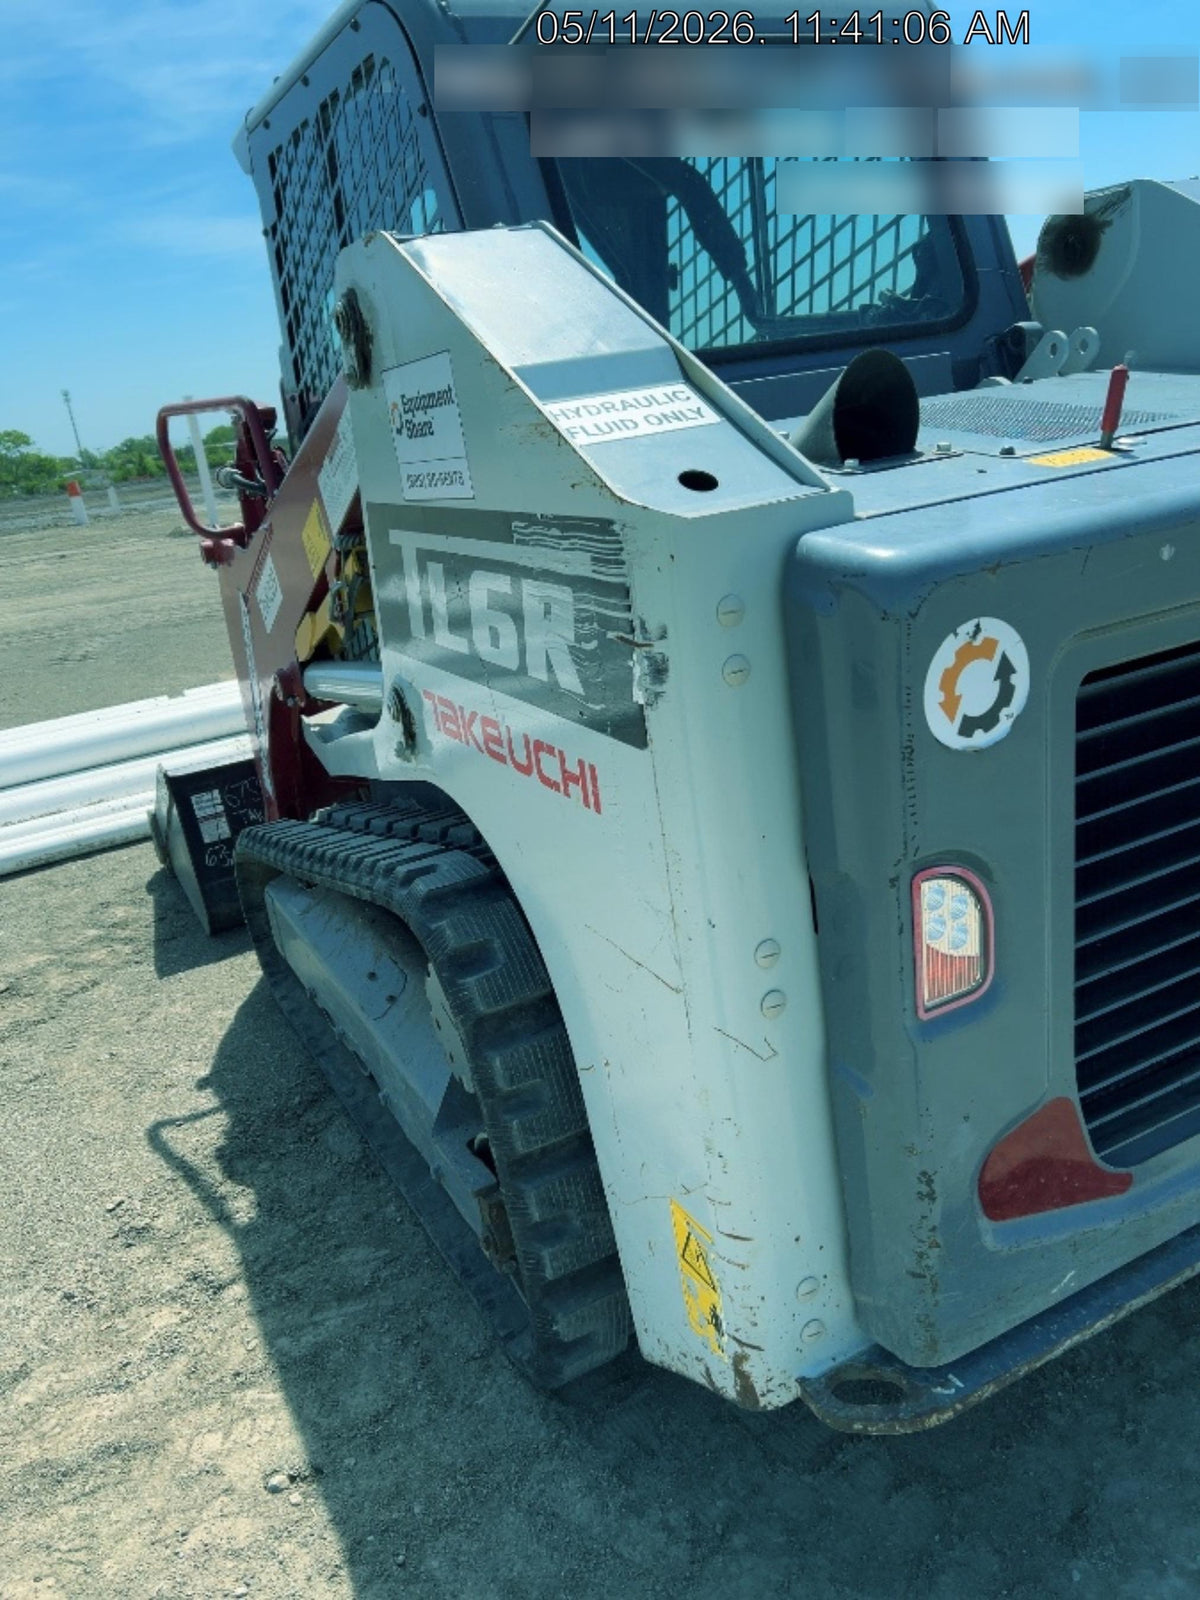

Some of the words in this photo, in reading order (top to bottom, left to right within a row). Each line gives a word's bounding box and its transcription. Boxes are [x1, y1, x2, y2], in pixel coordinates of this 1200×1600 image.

[401, 384, 455, 417] Equipment
[549, 391, 691, 421] HYDRAULIC
[565, 418, 639, 439] FLUID
[643, 407, 705, 426] ONLY
[423, 690, 601, 814] TAKEUCHI
